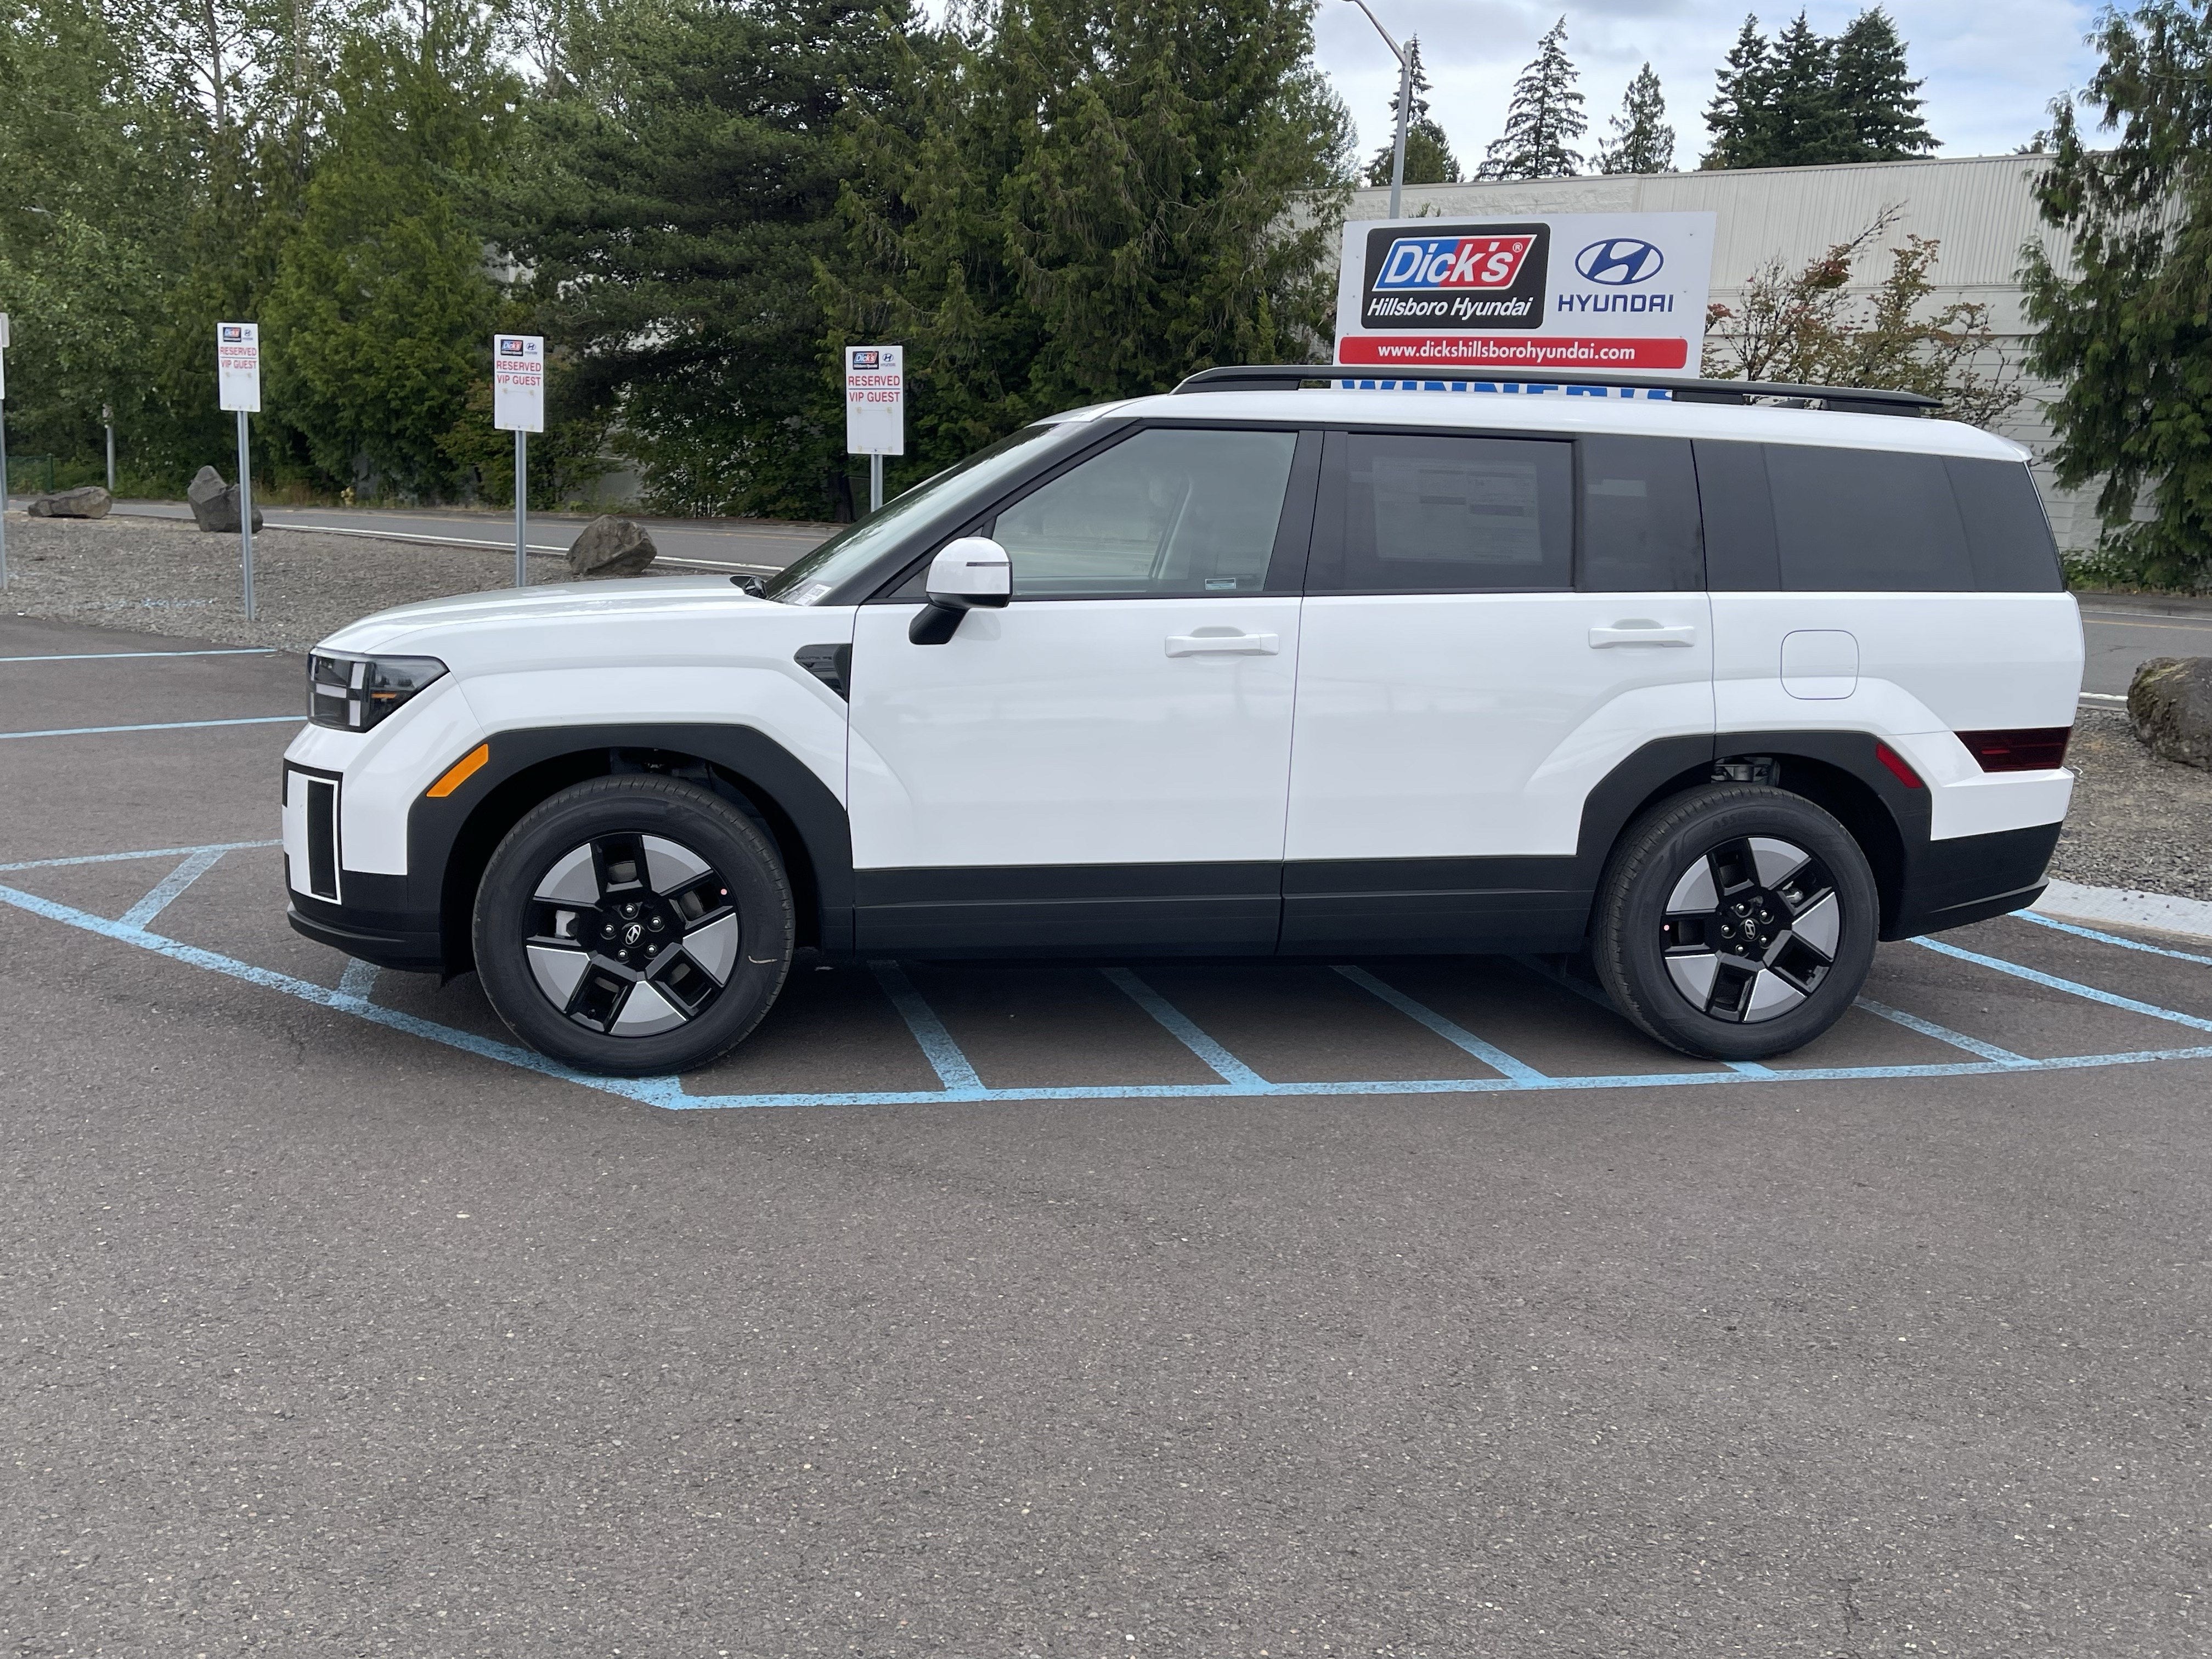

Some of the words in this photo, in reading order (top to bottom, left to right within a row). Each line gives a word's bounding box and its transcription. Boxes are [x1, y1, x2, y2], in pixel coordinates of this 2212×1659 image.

[1384, 242, 1514, 283] Dick's
[1367, 297, 1448, 317] Hillsboro
[1450, 297, 1534, 321] Hyundai
[1558, 294, 1674, 313] HYUNDAI
[220, 347, 256, 356] RESERVED
[1378, 341, 1635, 363] www.dickshillsborohyundai.com
[221, 360, 232, 368] VIP
[234, 360, 257, 369] GUEST
[496, 360, 541, 372] RESERVED
[497, 374, 510, 383] VIP
[512, 375, 541, 386] GUEST
[848, 376, 900, 386] RESERVED
[849, 392, 864, 402] VIP
[867, 392, 900, 402] GUEST
